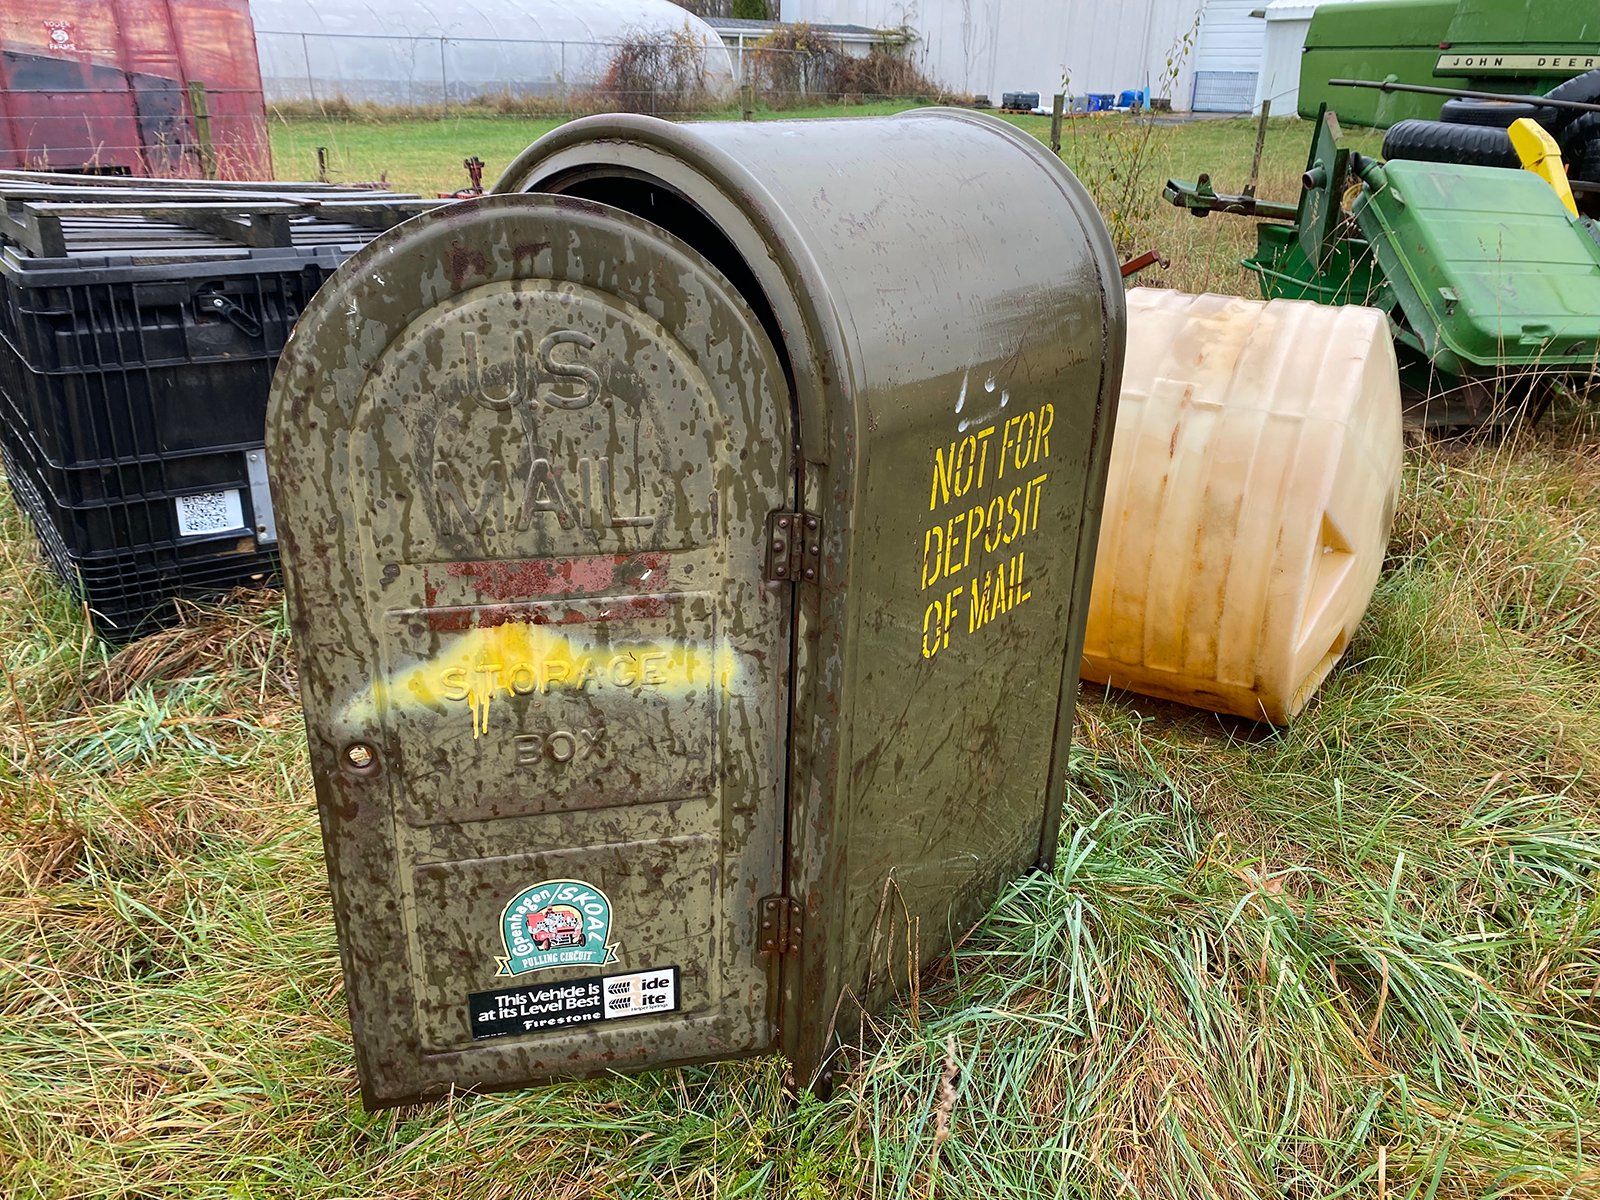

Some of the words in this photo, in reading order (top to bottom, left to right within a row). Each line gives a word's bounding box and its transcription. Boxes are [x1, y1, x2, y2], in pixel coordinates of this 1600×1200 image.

[1453, 57, 1503, 67] JOHN
[464, 330, 600, 411] US
[929, 425, 995, 511] NOT
[998, 403, 1054, 479] FOR
[433, 457, 654, 535] MAIL
[921, 473, 1048, 590] DEPOSIT
[922, 586, 963, 659] OF
[968, 552, 1032, 634] MAIL
[440, 651, 668, 700] STORAGE
[513, 727, 606, 766] BOX
[521, 952, 558, 969] PULLING
[560, 950, 592, 962] CIRCUIT
[478, 1009, 497, 1022] at
[499, 1007, 518, 1019] its
[520, 999, 562, 1016] Level
[565, 994, 601, 1010] Best
[495, 993, 527, 1008] This
[528, 985, 586, 1002] Vehicle
[588, 983, 600, 996] is
[523, 1012, 601, 1030] Firestone
